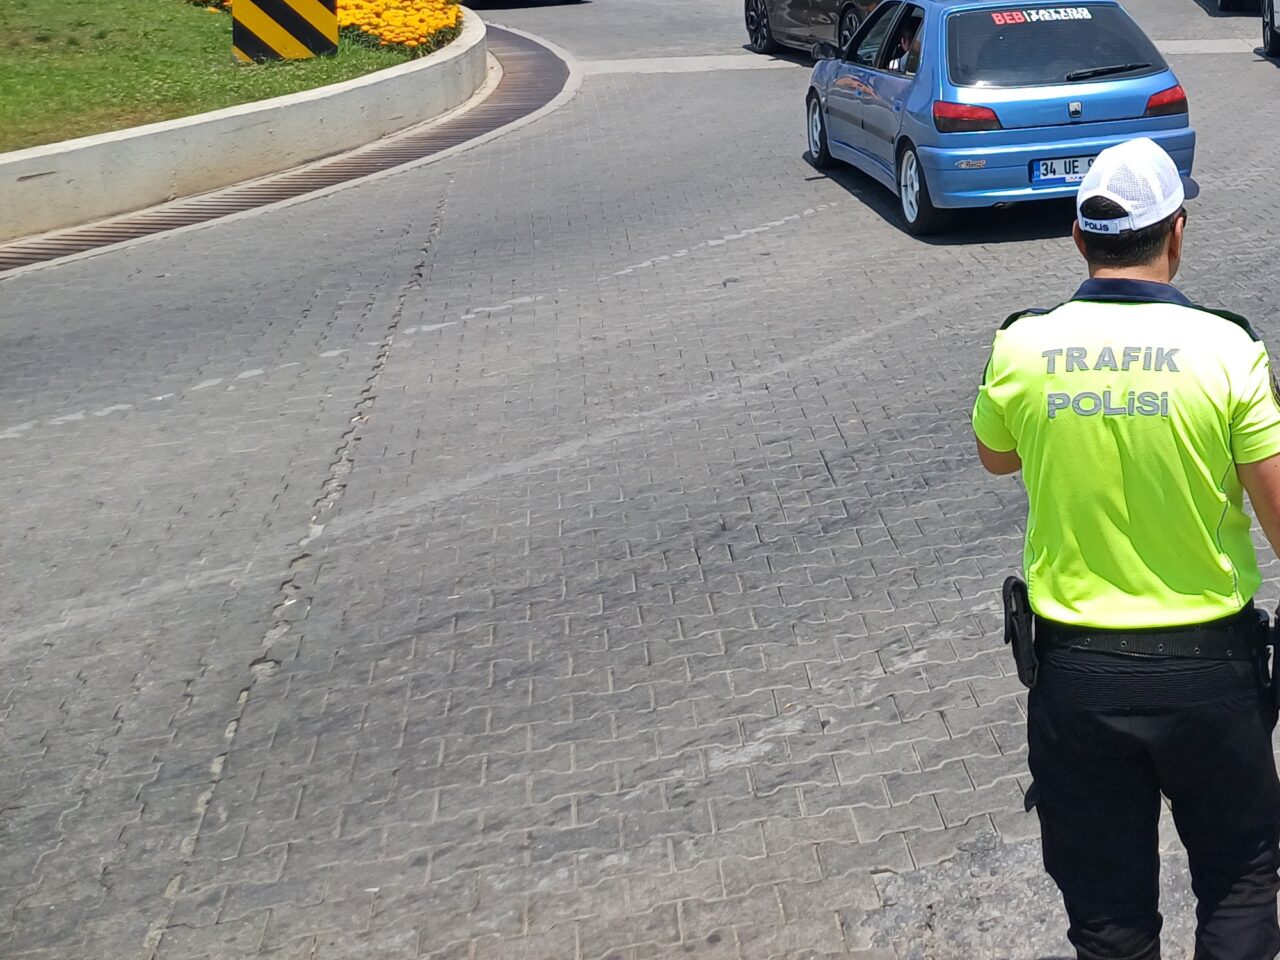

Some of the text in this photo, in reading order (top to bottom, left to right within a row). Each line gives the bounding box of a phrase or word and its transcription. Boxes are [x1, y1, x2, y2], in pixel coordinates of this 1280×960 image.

[991, 11, 1025, 25] BEB
[1041, 162, 1057, 176] 34
[1064, 159, 1080, 175] UE
